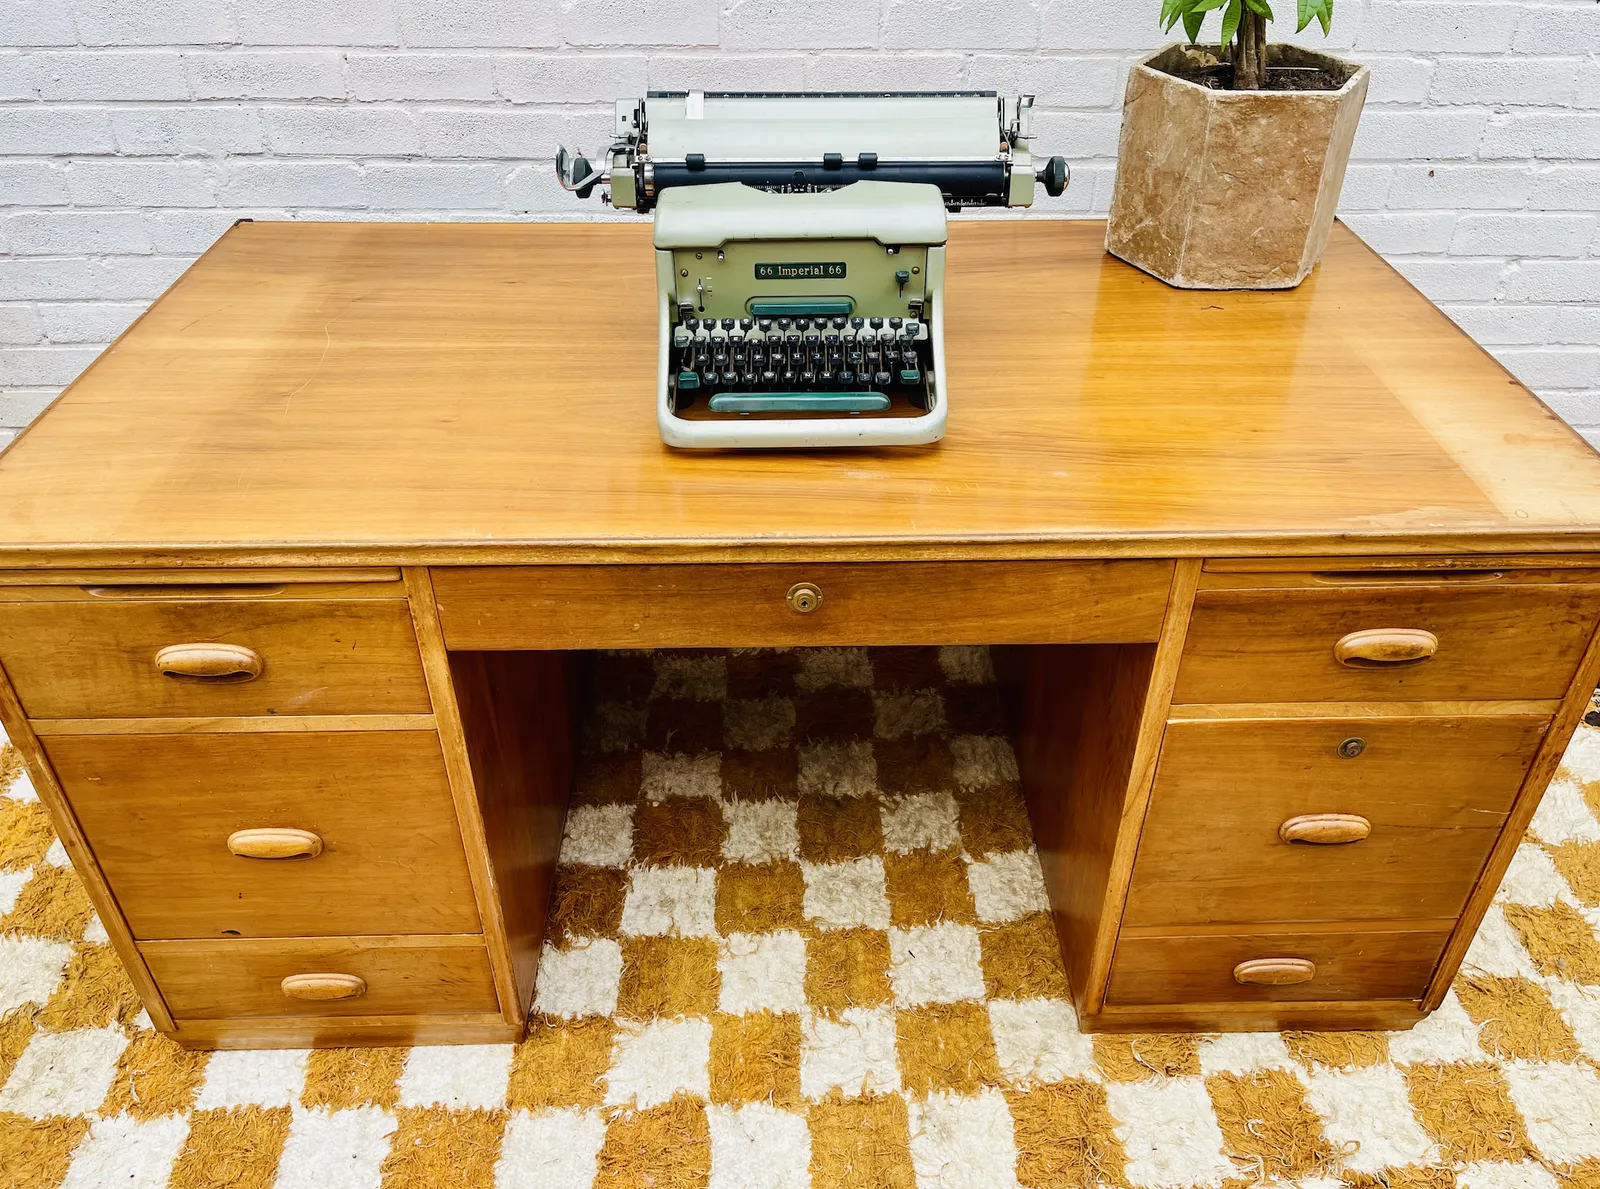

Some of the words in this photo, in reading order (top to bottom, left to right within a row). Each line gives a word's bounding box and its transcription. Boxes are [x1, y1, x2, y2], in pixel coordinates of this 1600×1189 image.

[759, 266, 773, 276] 66
[777, 265, 824, 277] Imperial
[828, 265, 842, 275] 66
